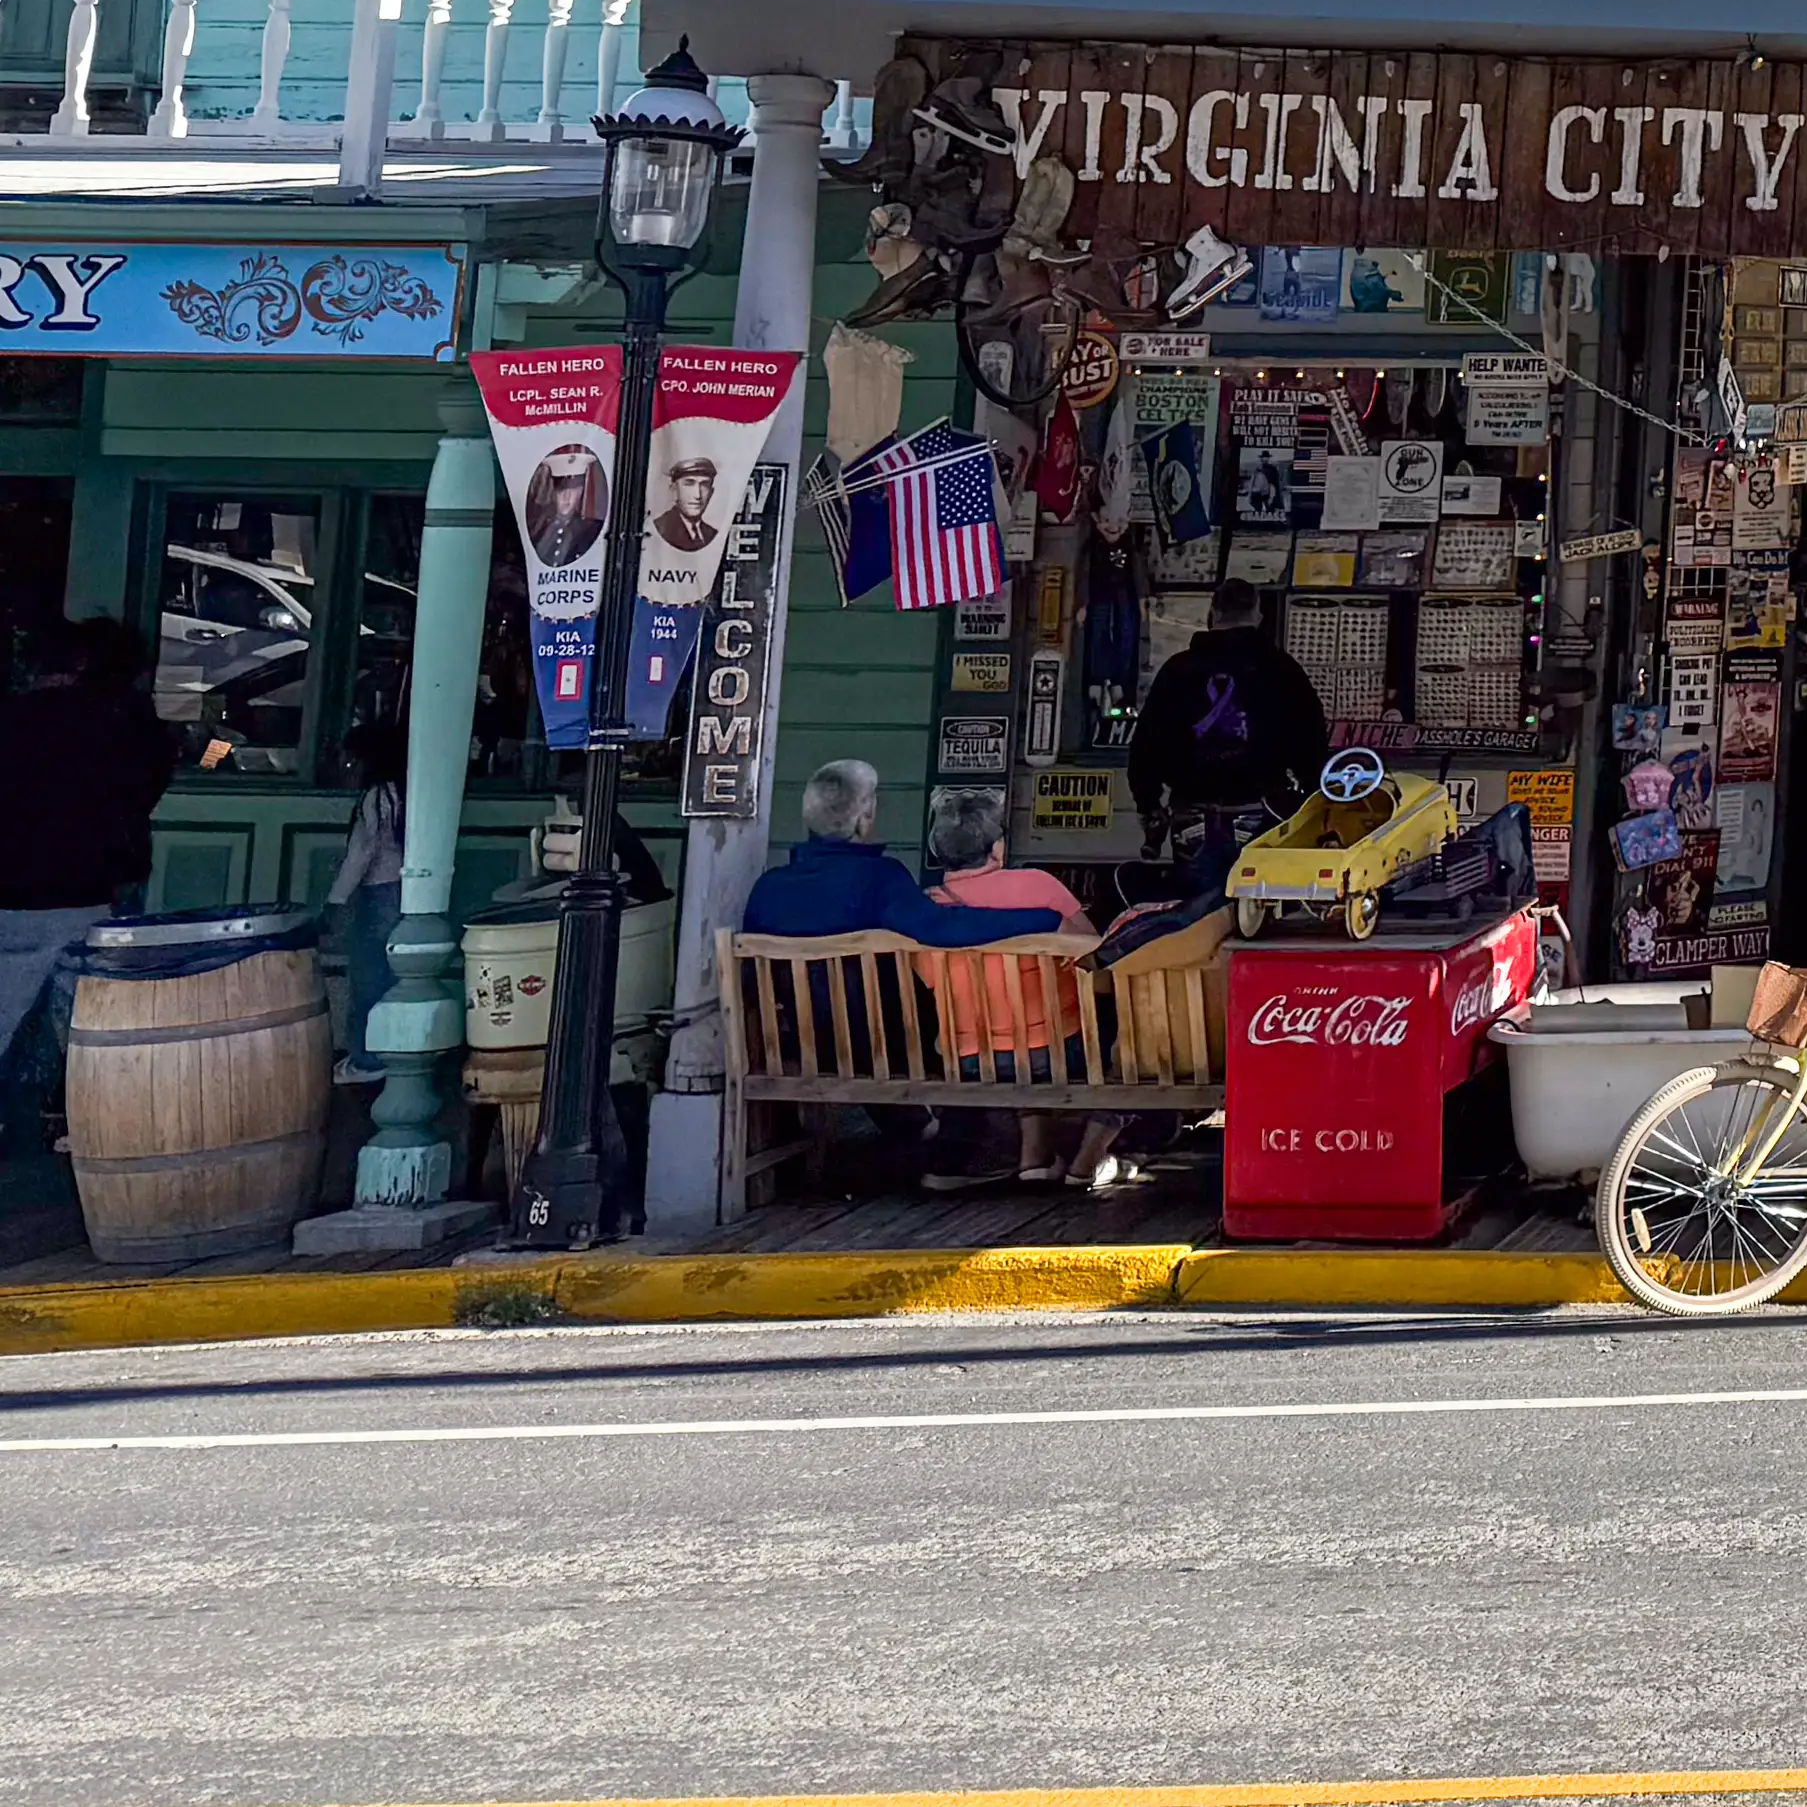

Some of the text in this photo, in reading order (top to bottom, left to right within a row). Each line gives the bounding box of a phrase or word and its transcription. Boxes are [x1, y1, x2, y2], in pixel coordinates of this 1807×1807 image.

[991, 88, 1499, 201] VIRGINIA
[1543, 104, 1805, 210] CITY
[500, 358, 604, 376] FALLEN HERO
[663, 356, 778, 375] FALLEN HERO
[1468, 358, 1548, 372] HELP WANTE
[510, 386, 604, 402] LCPL. SEAN R.
[661, 380, 775, 398] CPO. JOHN MERIAN
[1234, 389, 1281, 402] PLAY IT
[1136, 395, 1209, 408] BOSTON
[525, 402, 586, 416] McMILLIN
[1137, 409, 1206, 422] CELTICS
[1484, 420, 1542, 428] Years AFTER
[1401, 448, 1423, 457] GUN
[1747, 552, 1764, 565] Can
[1764, 552, 1777, 565] Do
[538, 568, 600, 585] MARINE
[648, 568, 697, 584] NAVY
[537, 590, 594, 605] CORPS
[1674, 602, 1719, 614] WARNING
[654, 616, 675, 628] KIA
[556, 630, 581, 642] KIA
[650, 628, 678, 640] 1944
[696, 475, 774, 805] WELCOME
[538, 644, 596, 656] 09-28-12
[956, 656, 1008, 666] I MISSED
[970, 668, 996, 680] YOU
[982, 680, 1006, 690] GOD
[1422, 728, 1532, 749] ASSHOLE'S GARAGE
[946, 740, 1001, 754] TEQUILA
[1038, 775, 1108, 796] CAUTION
[1510, 774, 1572, 786] MY WIFE
[1532, 828, 1569, 841] NGER
[1692, 854, 1714, 870] 911
[1717, 905, 1756, 914] PLEASE
[1654, 932, 1762, 966] CLAMPER WAY
[1293, 986, 1339, 995] DRINK
[1248, 994, 1414, 1046] Coca-Cola
[1261, 1128, 1395, 1152] ICE COLD
[528, 1200, 548, 1226] 65
